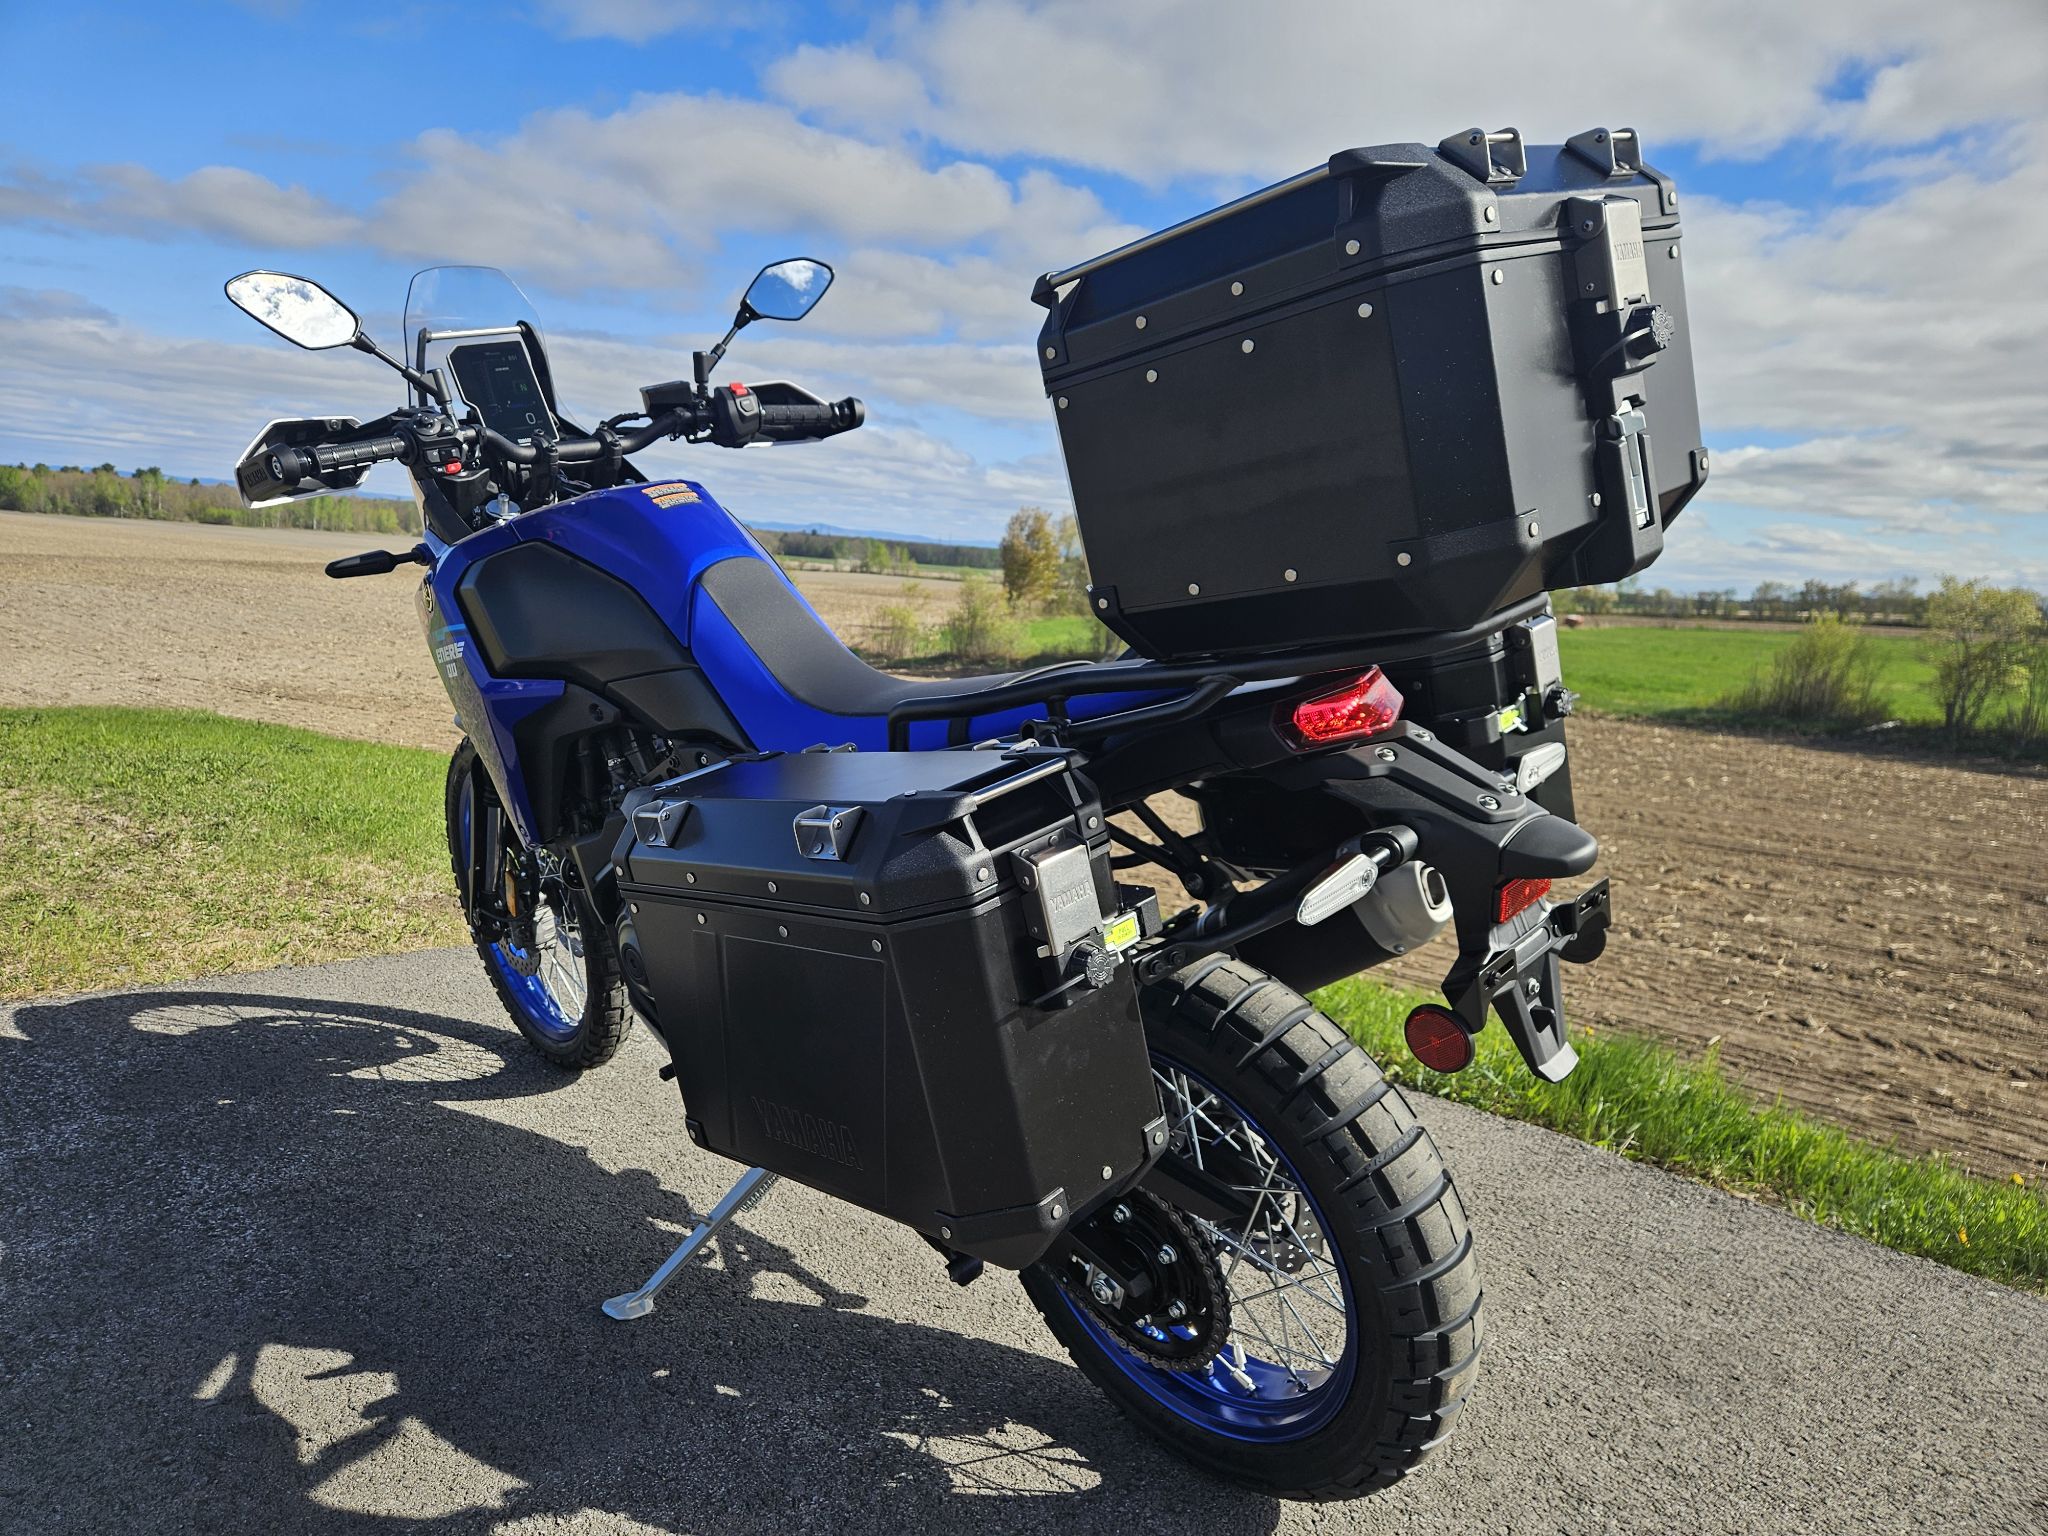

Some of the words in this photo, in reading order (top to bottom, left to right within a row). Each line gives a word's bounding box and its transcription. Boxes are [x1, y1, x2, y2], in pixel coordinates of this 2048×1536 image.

[525, 412, 536, 425] 0
[435, 641, 465, 664] ENERE
[445, 663, 458, 678] 00
[1049, 880, 1093, 913] YAMAHA
[751, 1096, 864, 1171] YAMAHA
